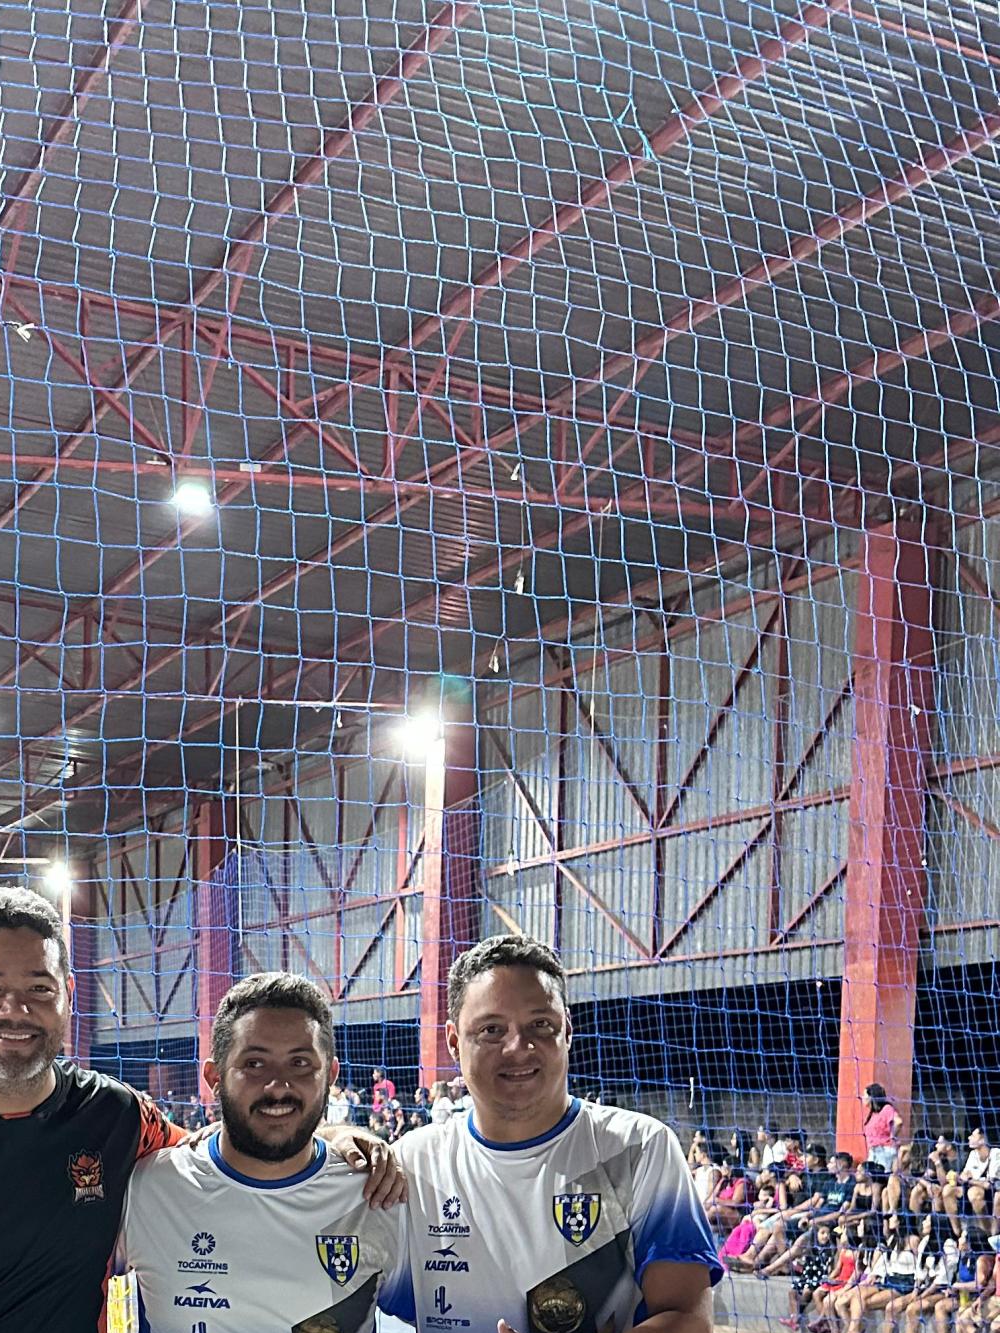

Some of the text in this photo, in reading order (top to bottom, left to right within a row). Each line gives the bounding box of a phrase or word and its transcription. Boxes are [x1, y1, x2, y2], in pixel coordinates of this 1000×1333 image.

[428, 1225, 470, 1233] TOCANTINS
[177, 1261, 229, 1271] TOCANTINS
[424, 1260, 470, 1272] KAGIVA
[174, 1295, 231, 1309] KAGIVA
[426, 1316, 471, 1327] SPORTS
